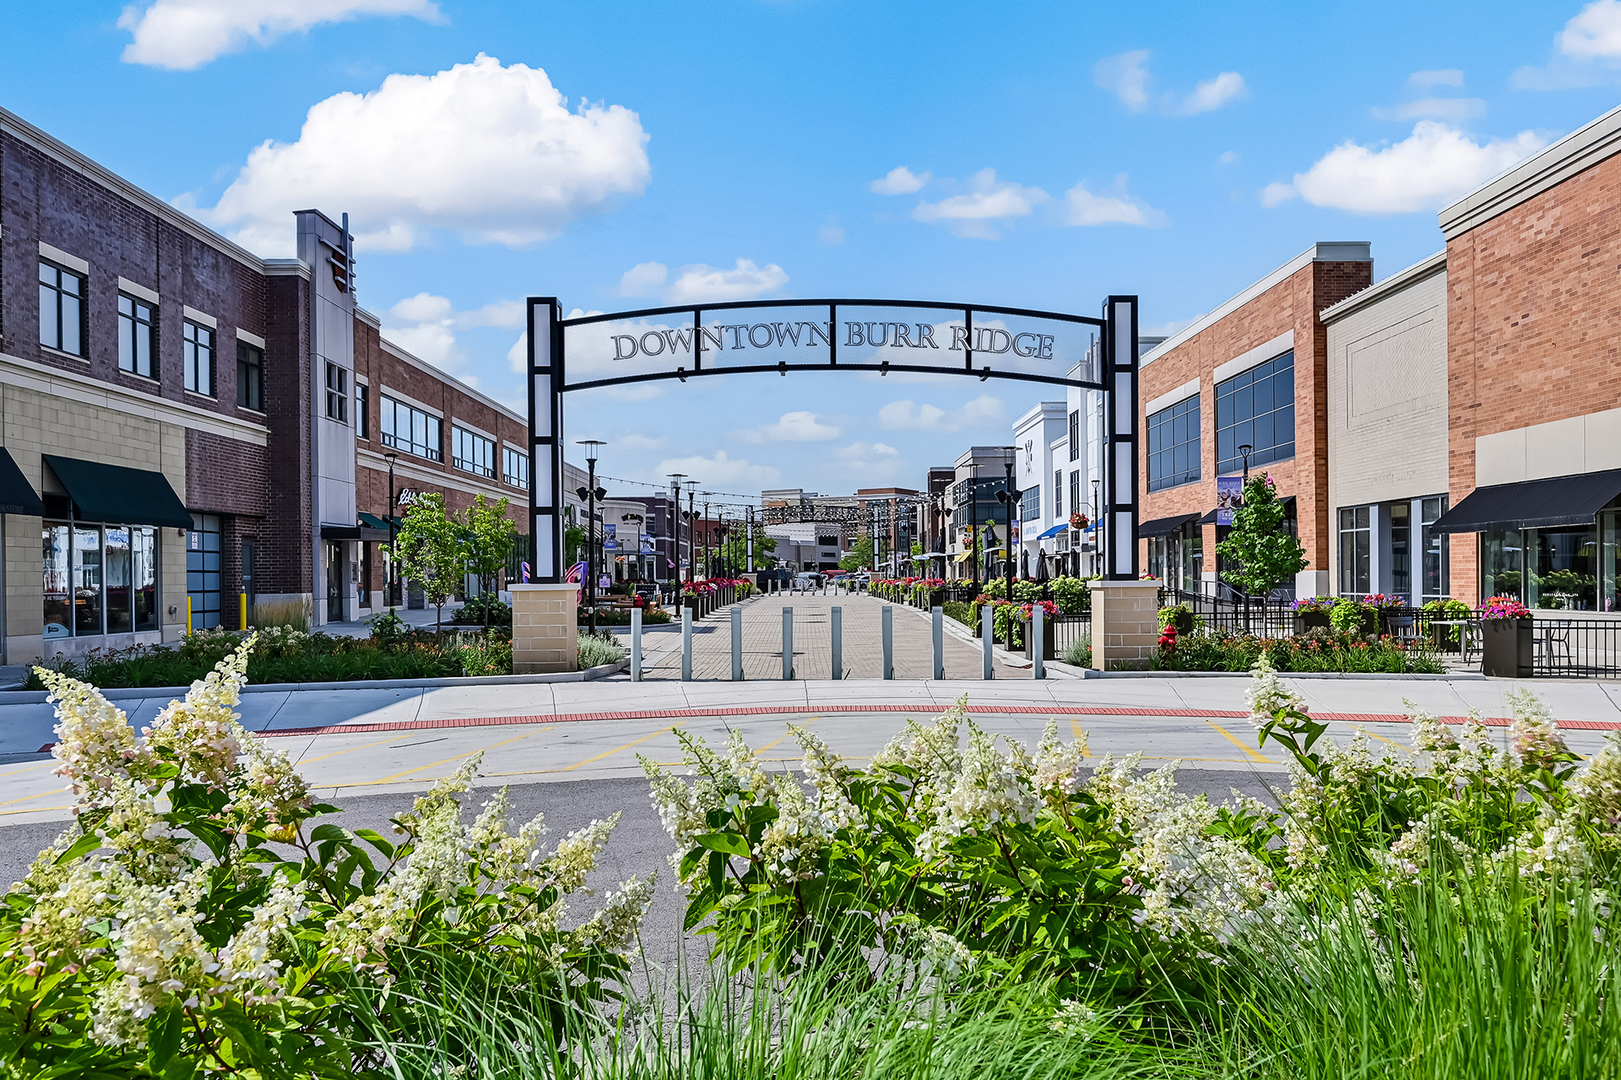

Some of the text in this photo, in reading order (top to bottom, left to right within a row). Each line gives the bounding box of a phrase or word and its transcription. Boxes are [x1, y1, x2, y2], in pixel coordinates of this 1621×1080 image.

[610, 321, 1054, 361] DOWNTOWN BURR RIDGE
